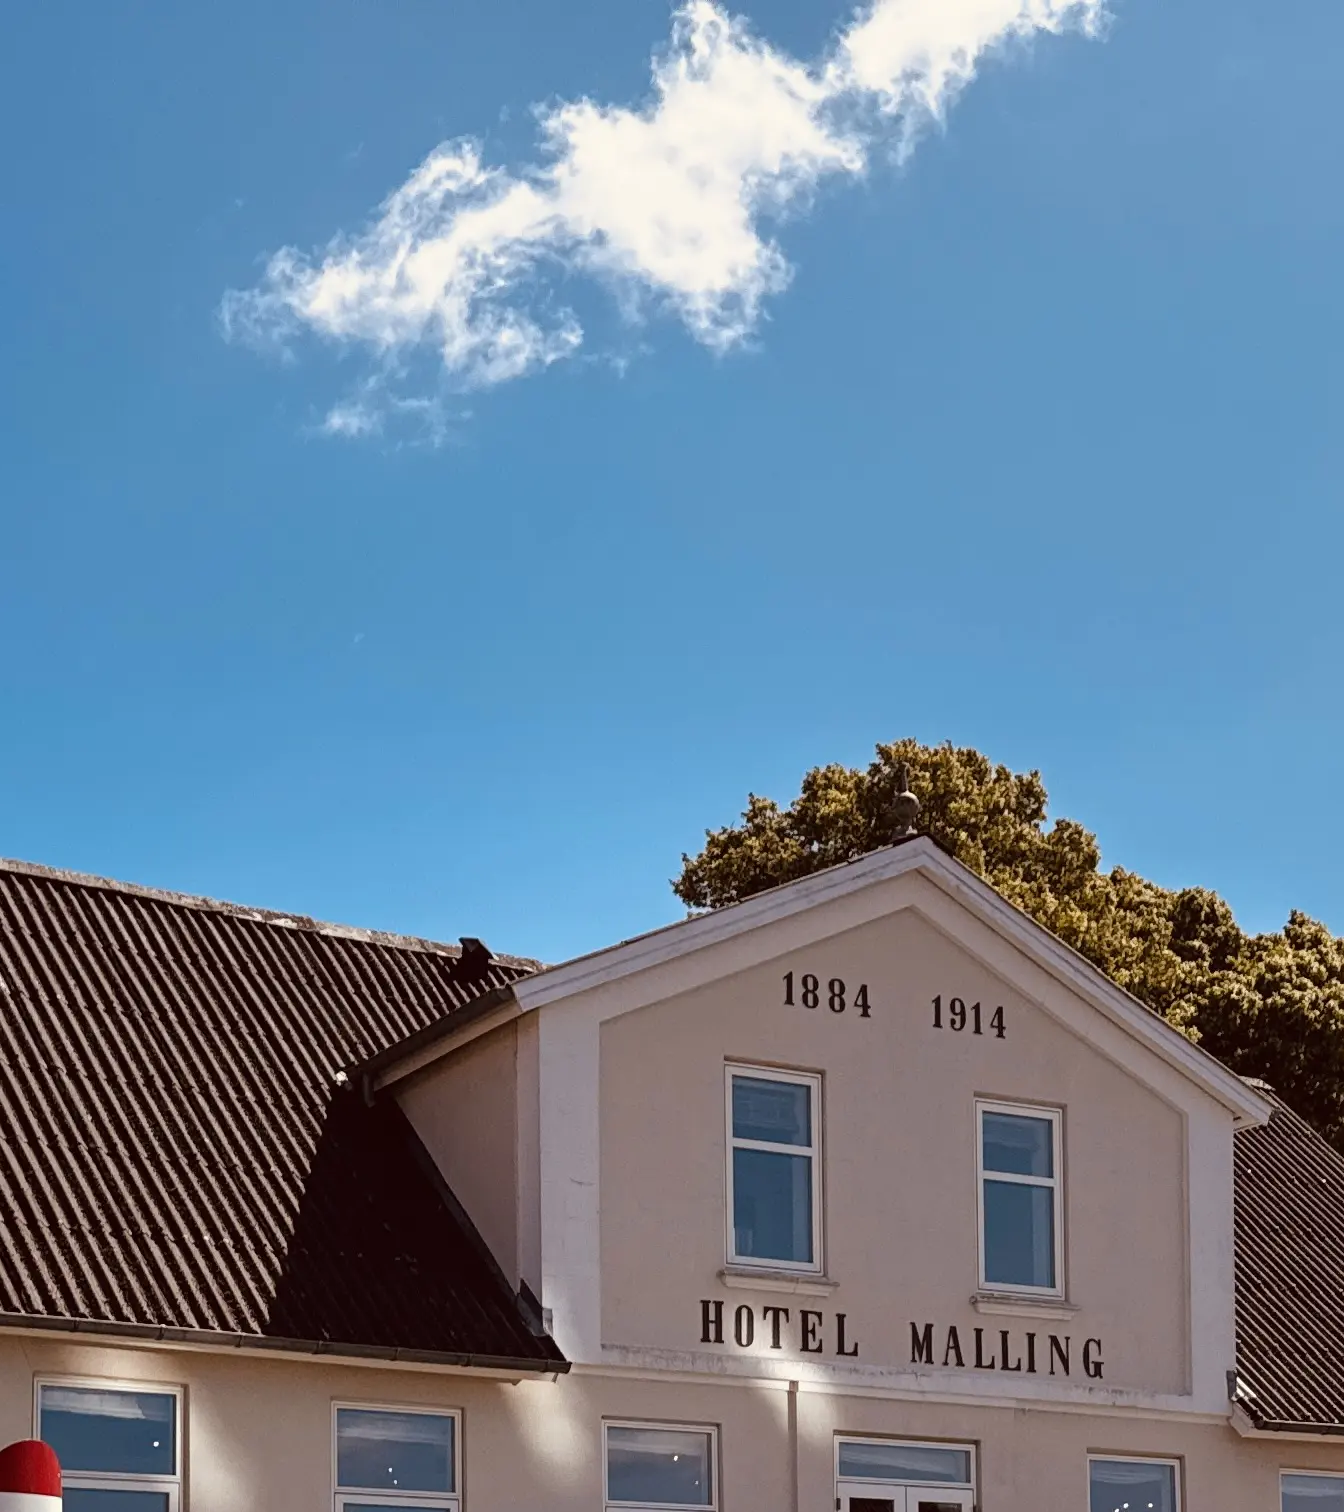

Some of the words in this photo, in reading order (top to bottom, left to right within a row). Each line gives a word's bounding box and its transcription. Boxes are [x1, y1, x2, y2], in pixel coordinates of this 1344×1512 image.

[782, 970, 872, 1018] 1884
[931, 994, 1007, 1040] 1914
[699, 1299, 859, 1356] HOTEL
[909, 1321, 1105, 1379] MALLING
